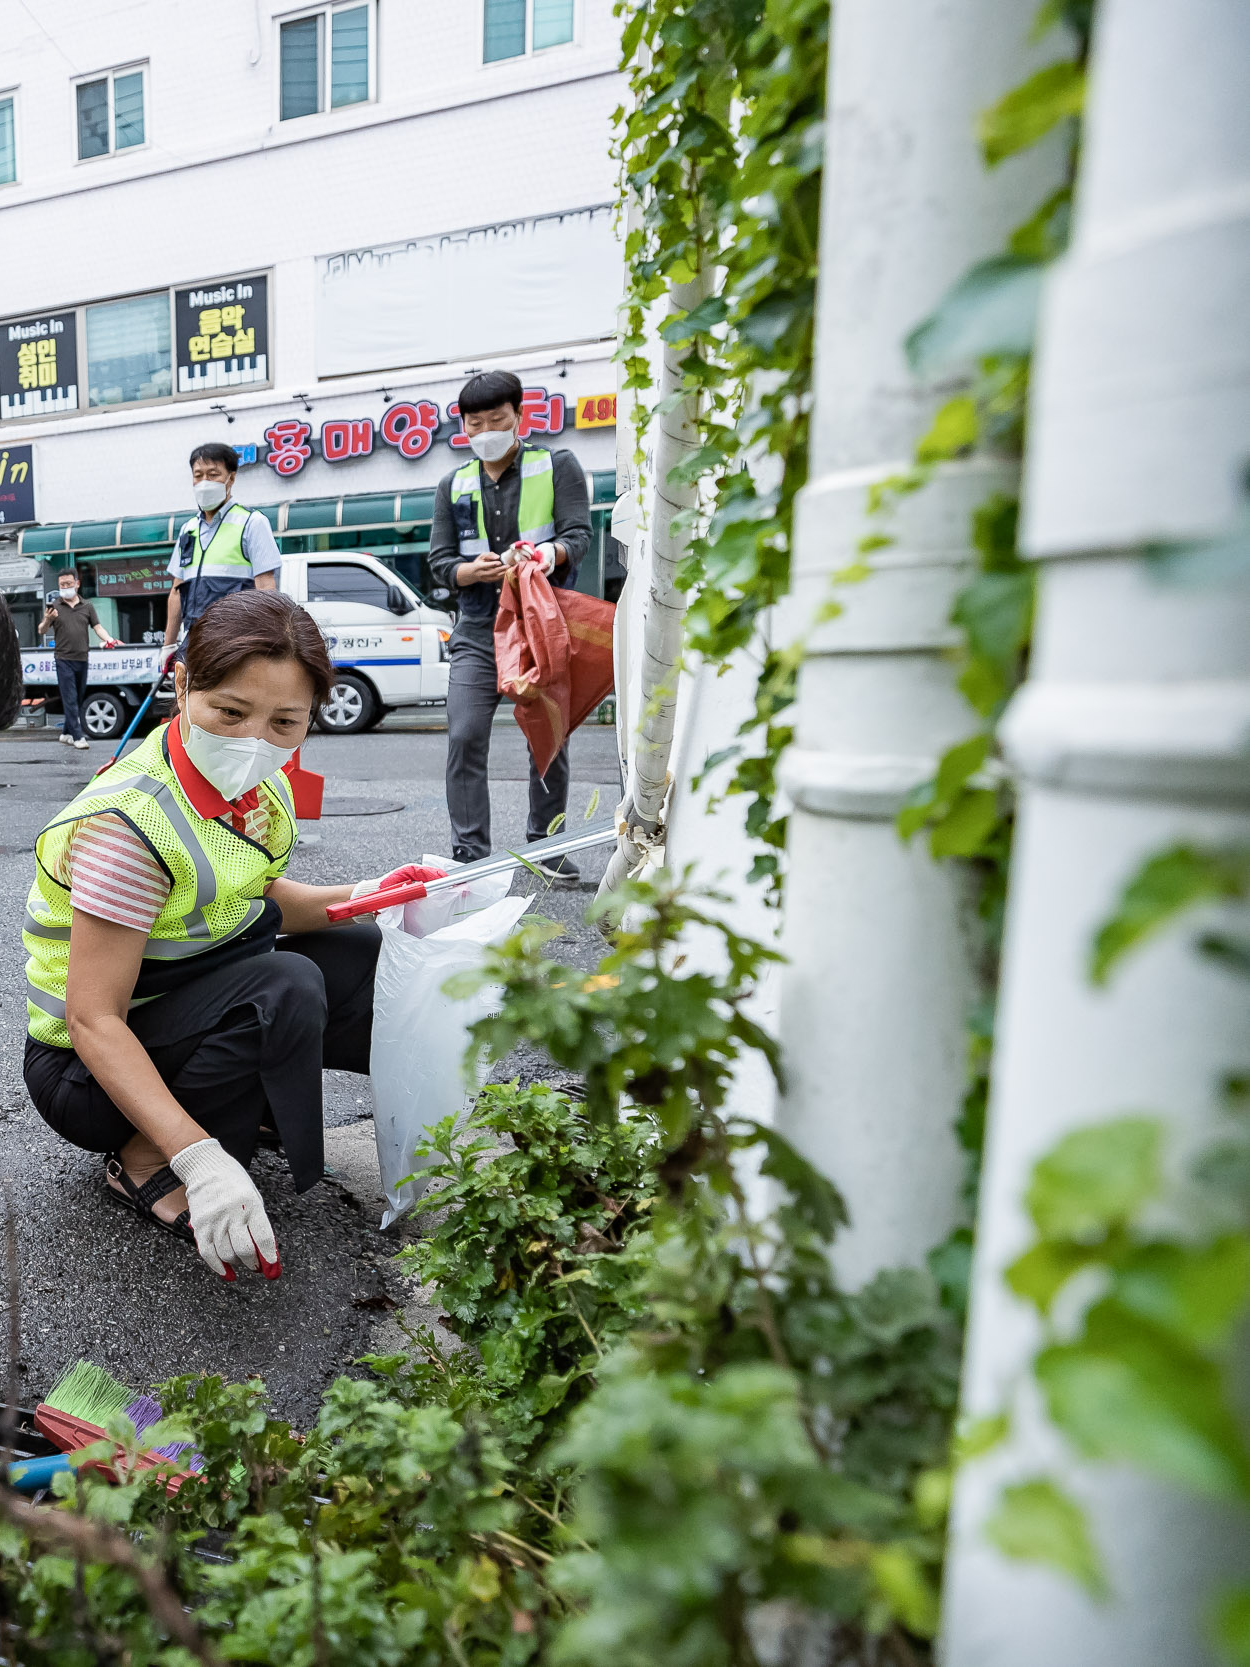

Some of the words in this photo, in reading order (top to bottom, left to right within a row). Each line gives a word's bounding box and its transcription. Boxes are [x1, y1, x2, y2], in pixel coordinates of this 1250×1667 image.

[189, 286, 235, 308] Music
[236, 283, 253, 300] In
[8, 321, 49, 342] Music
[49, 320, 65, 334] In
[199, 304, 246, 336] 음악
[17, 338, 57, 366] 성인
[188, 327, 255, 362] 연습실
[18, 362, 58, 389] 취미
[342, 637, 382, 648] 광진구
